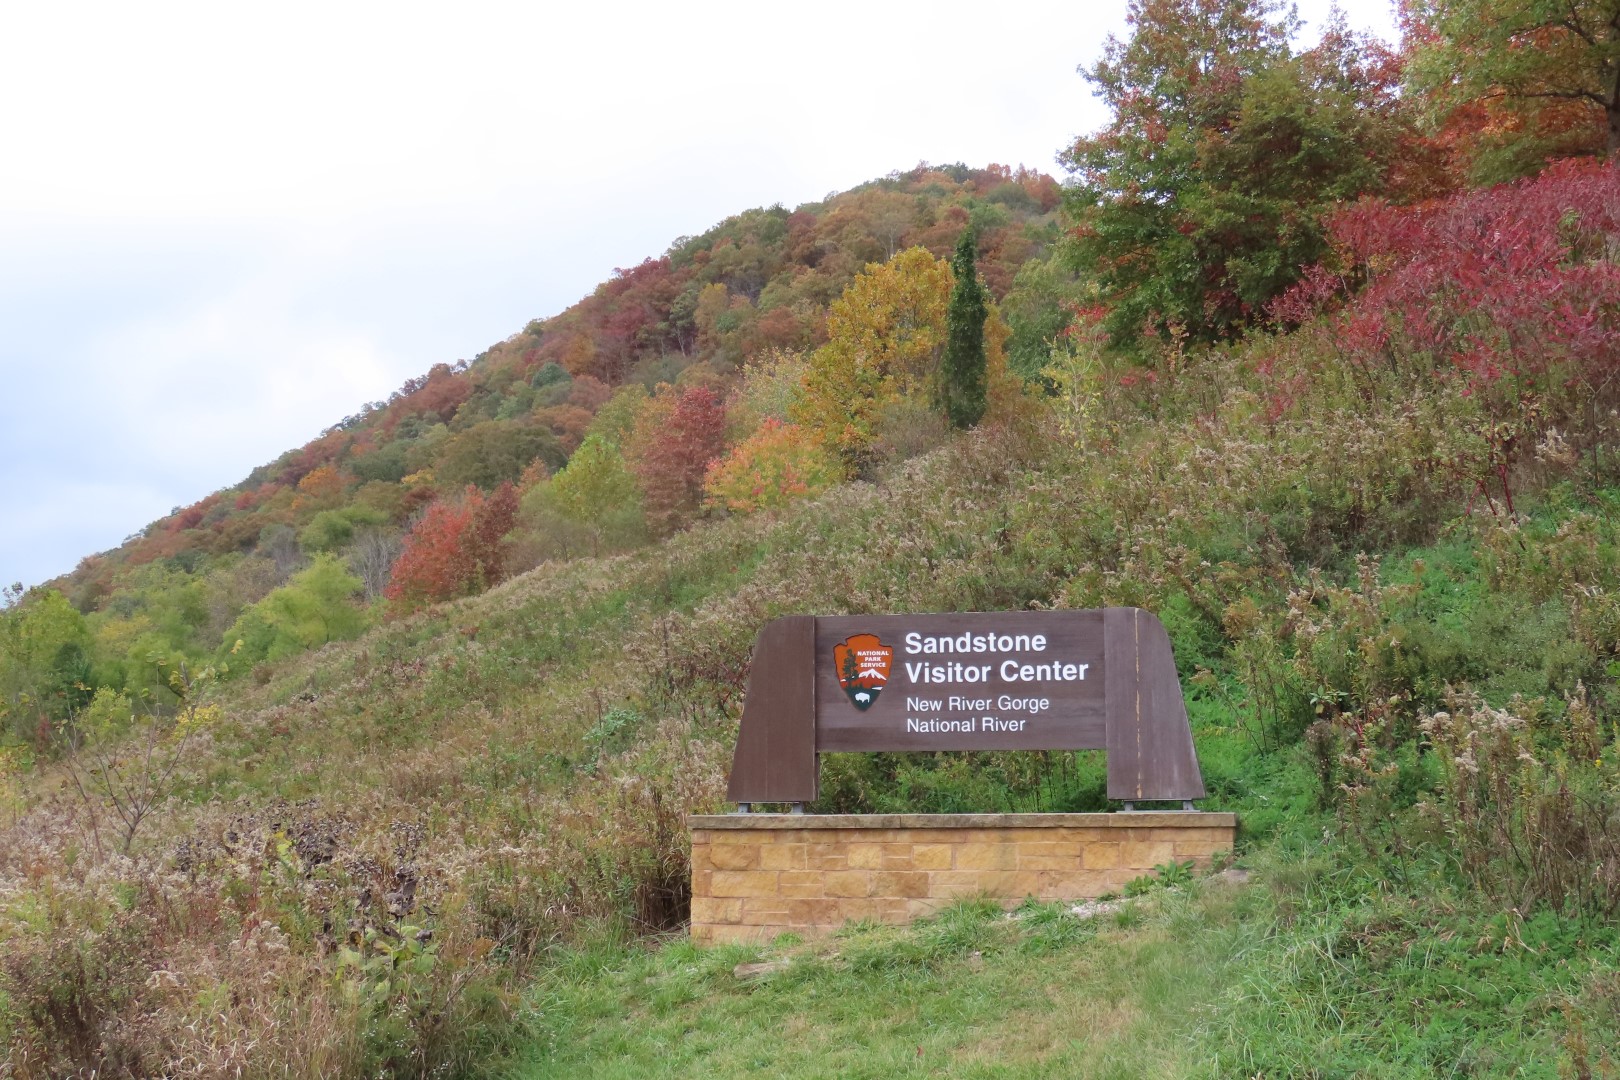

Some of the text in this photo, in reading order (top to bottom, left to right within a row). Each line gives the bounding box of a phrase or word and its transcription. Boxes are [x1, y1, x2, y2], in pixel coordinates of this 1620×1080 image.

[906, 631, 1047, 654] Sandstone
[905, 660, 1089, 683] Visitor Center
[906, 694, 1050, 714] New River Gorge
[906, 716, 1026, 733] National River
